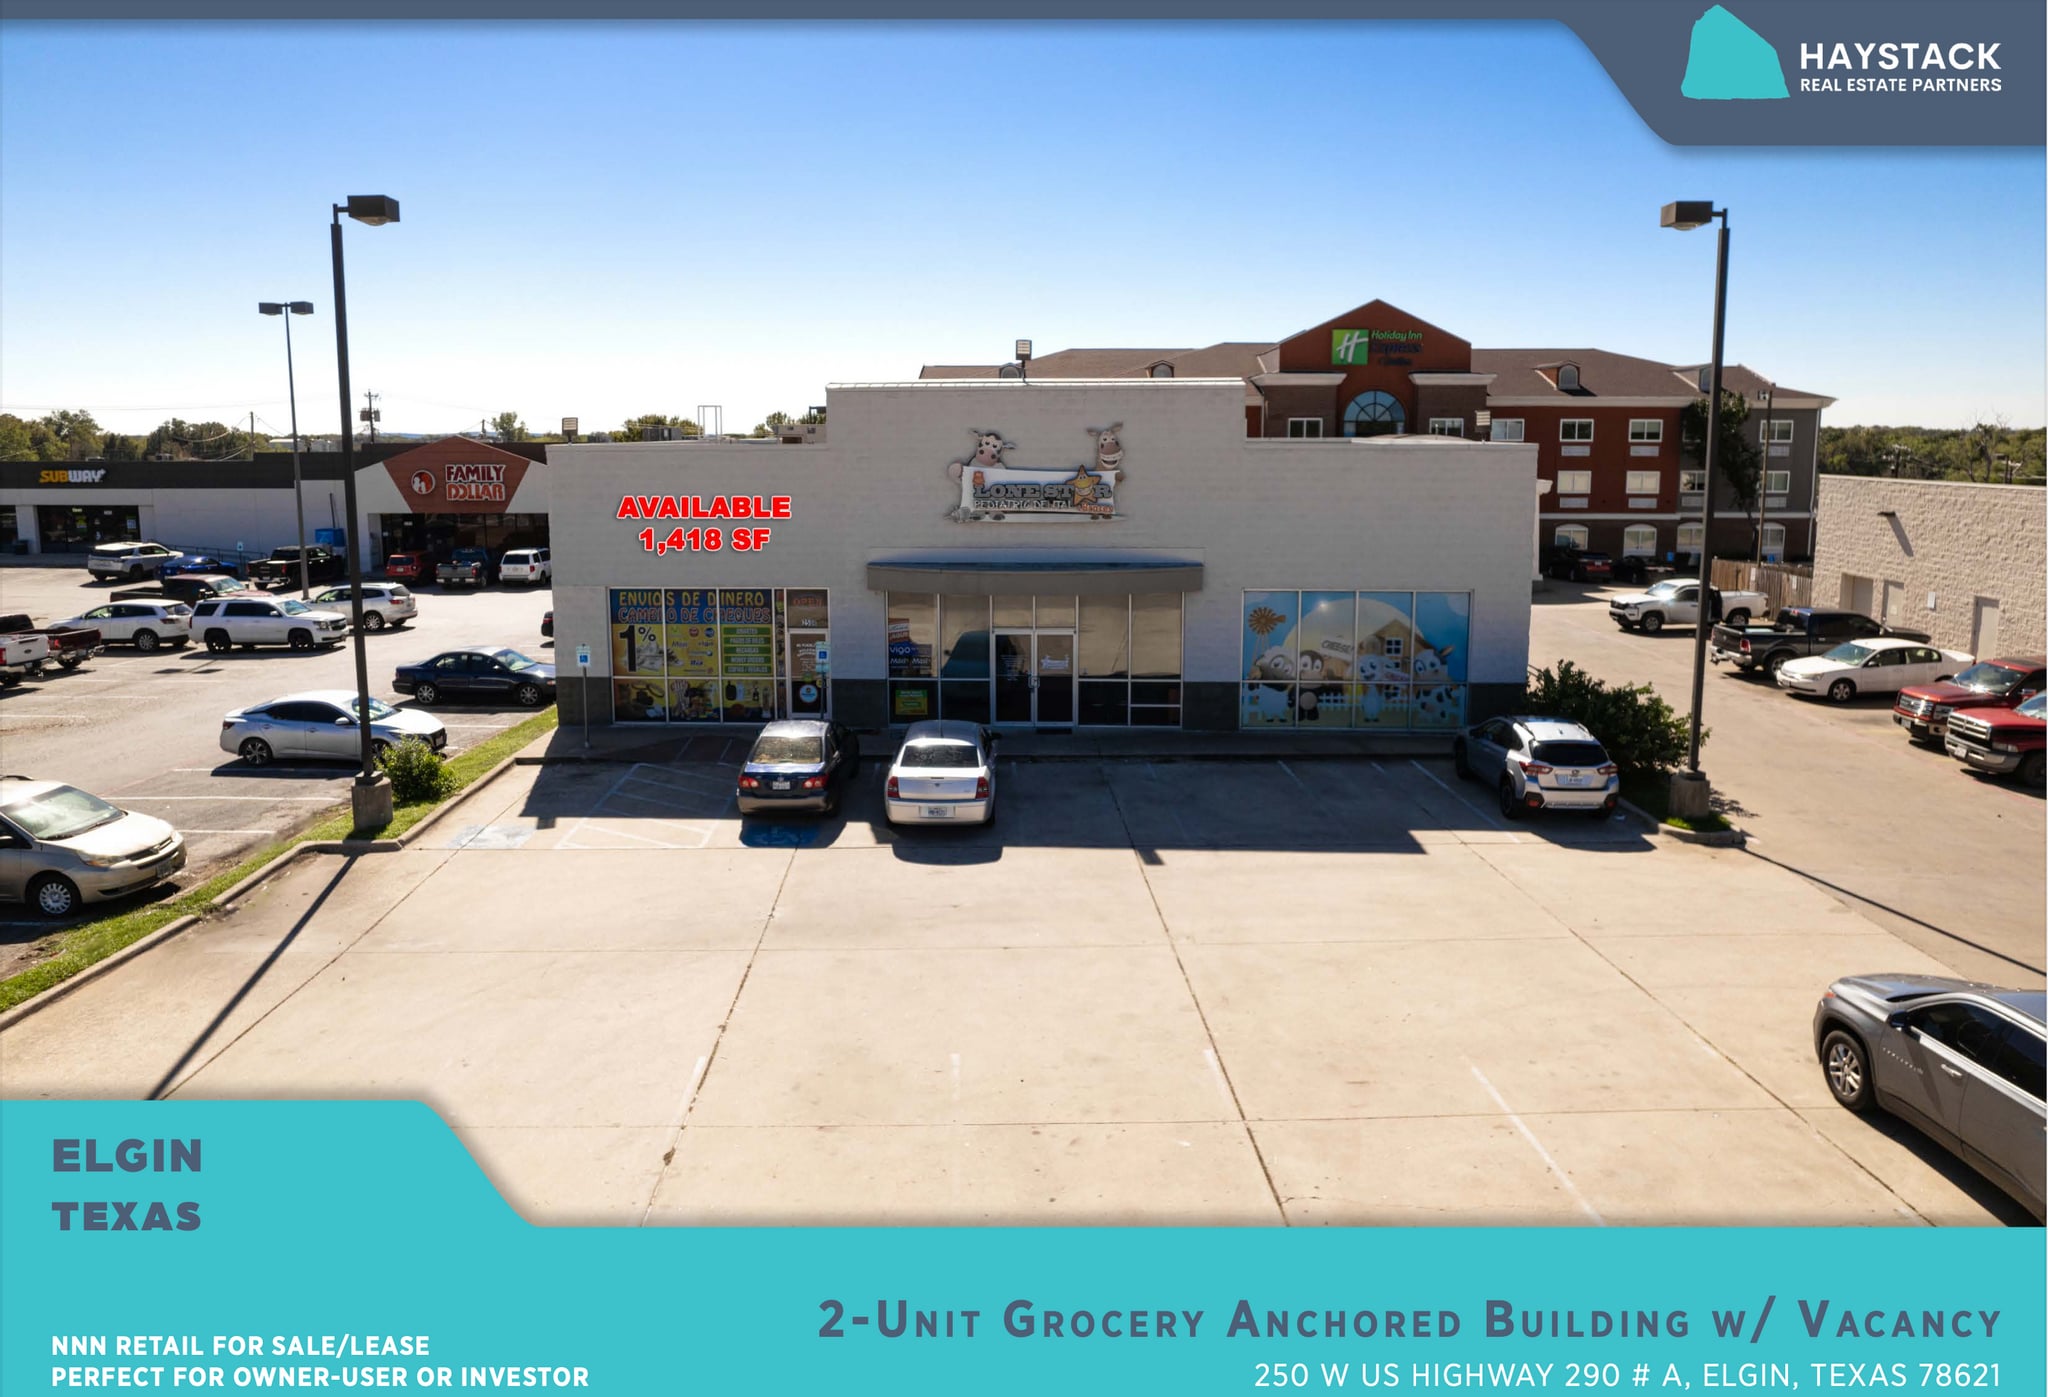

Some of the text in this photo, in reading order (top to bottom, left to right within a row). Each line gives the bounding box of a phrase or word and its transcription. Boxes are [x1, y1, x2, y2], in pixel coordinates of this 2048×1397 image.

[1371, 330, 1423, 341] Holiday Inn
[39, 468, 107, 484] SUBWAY
[445, 463, 506, 482] FAMILY
[445, 483, 506, 501] DOLLAR
[974, 484, 1041, 498] LONE
[974, 499, 1030, 510] PEDIATRIC
[619, 591, 765, 606] ENVIOS DE DINERO
[618, 607, 771, 624] CAMBIO DE CHEQUES
[619, 625, 657, 673] 1%
